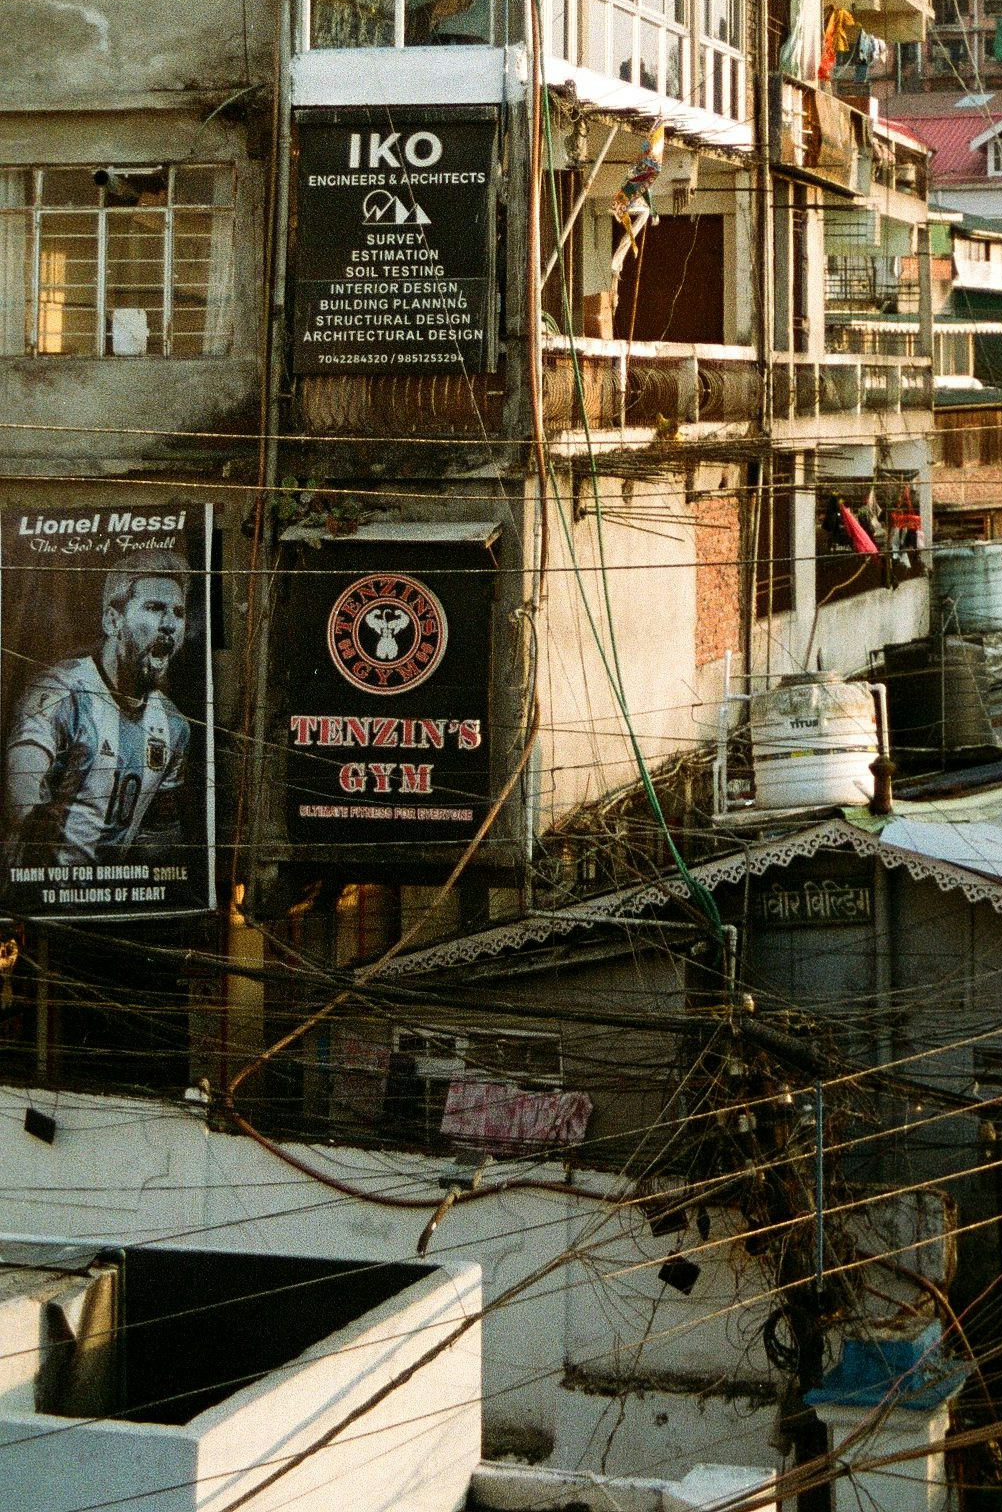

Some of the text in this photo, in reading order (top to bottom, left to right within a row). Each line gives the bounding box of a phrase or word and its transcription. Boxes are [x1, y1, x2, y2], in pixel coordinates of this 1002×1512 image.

[349, 131, 443, 169] IKO
[308, 172, 486, 187] ENGINEERS & ARCHITECTS
[366, 234, 425, 246] SURVEY
[352, 249, 439, 261] ESTIMATION
[346, 265, 445, 278] SOIL TESTING
[330, 282, 458, 295] INTERIOR DESIGN
[320, 298, 468, 311] BUILDING PLANNING
[316, 313, 471, 326] STRUCTURAL DESIGN
[303, 329, 483, 342] ARCHITECTURAL DESIGN
[19, 511, 187, 536] Lionel Messi
[30, 535, 176, 554] The God of Football
[352, 659, 421, 685] GYM
[339, 762, 434, 793] GYM
[394, 807, 417, 820] FOR
[11, 865, 188, 883] THANK YOU FOR BRINGING SMILE
[42, 886, 166, 904] TO MILLIONS OF HEART
